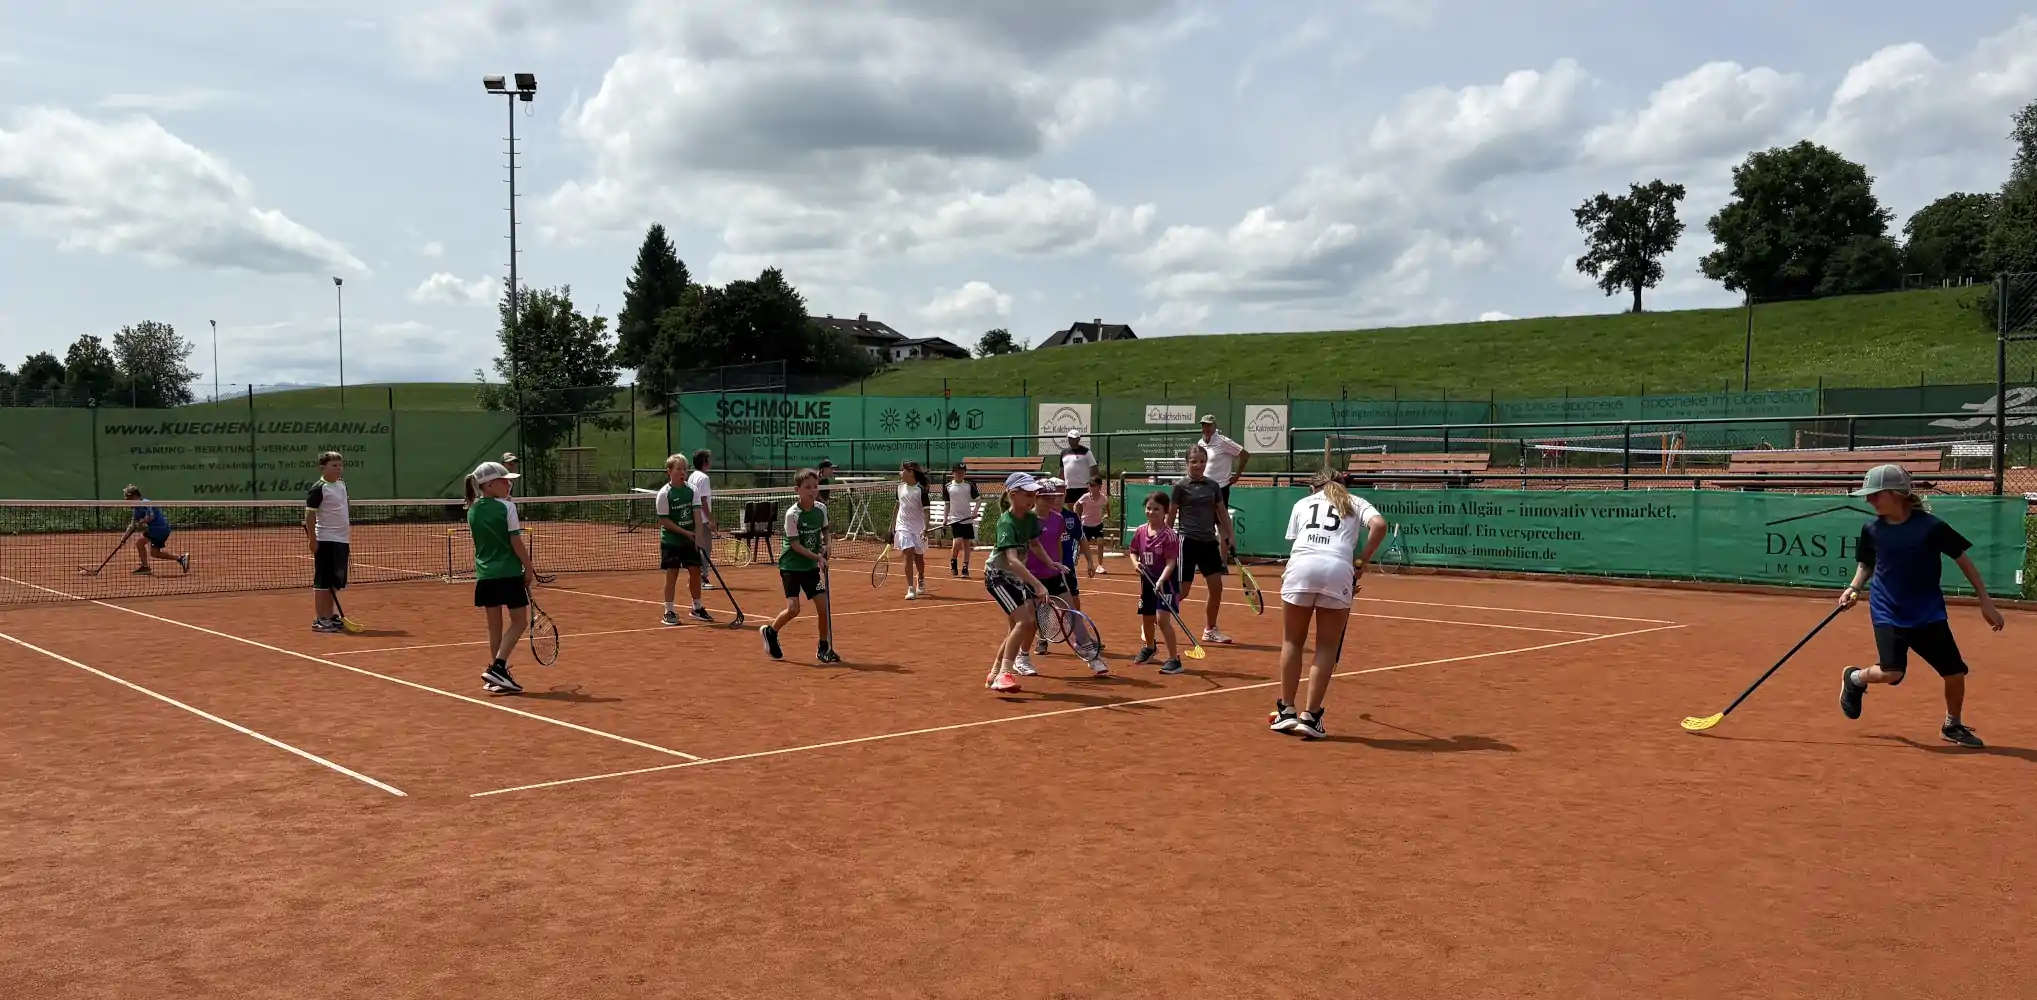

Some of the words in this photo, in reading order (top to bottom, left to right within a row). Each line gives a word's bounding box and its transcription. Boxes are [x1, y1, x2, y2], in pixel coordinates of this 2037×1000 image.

[87, 397, 96, 407] 2
[716, 399, 832, 419] SCHMOLKE
[1305, 503, 1341, 532] 15
[1438, 500, 1455, 515] im
[1456, 501, 1502, 518] Allgäu
[1519, 502, 1588, 518] innovativ
[1590, 503, 1677, 519] vermarket.
[1307, 533, 1331, 546] Mimi
[1403, 523, 1420, 536] als
[1422, 523, 1472, 537] Verkauf.
[1476, 524, 1497, 537] Ein
[1500, 526, 1586, 542] versprechen.
[1399, 543, 1557, 561] ww.dashaus-immobilien.de
[1765, 532, 1828, 558] DAS
